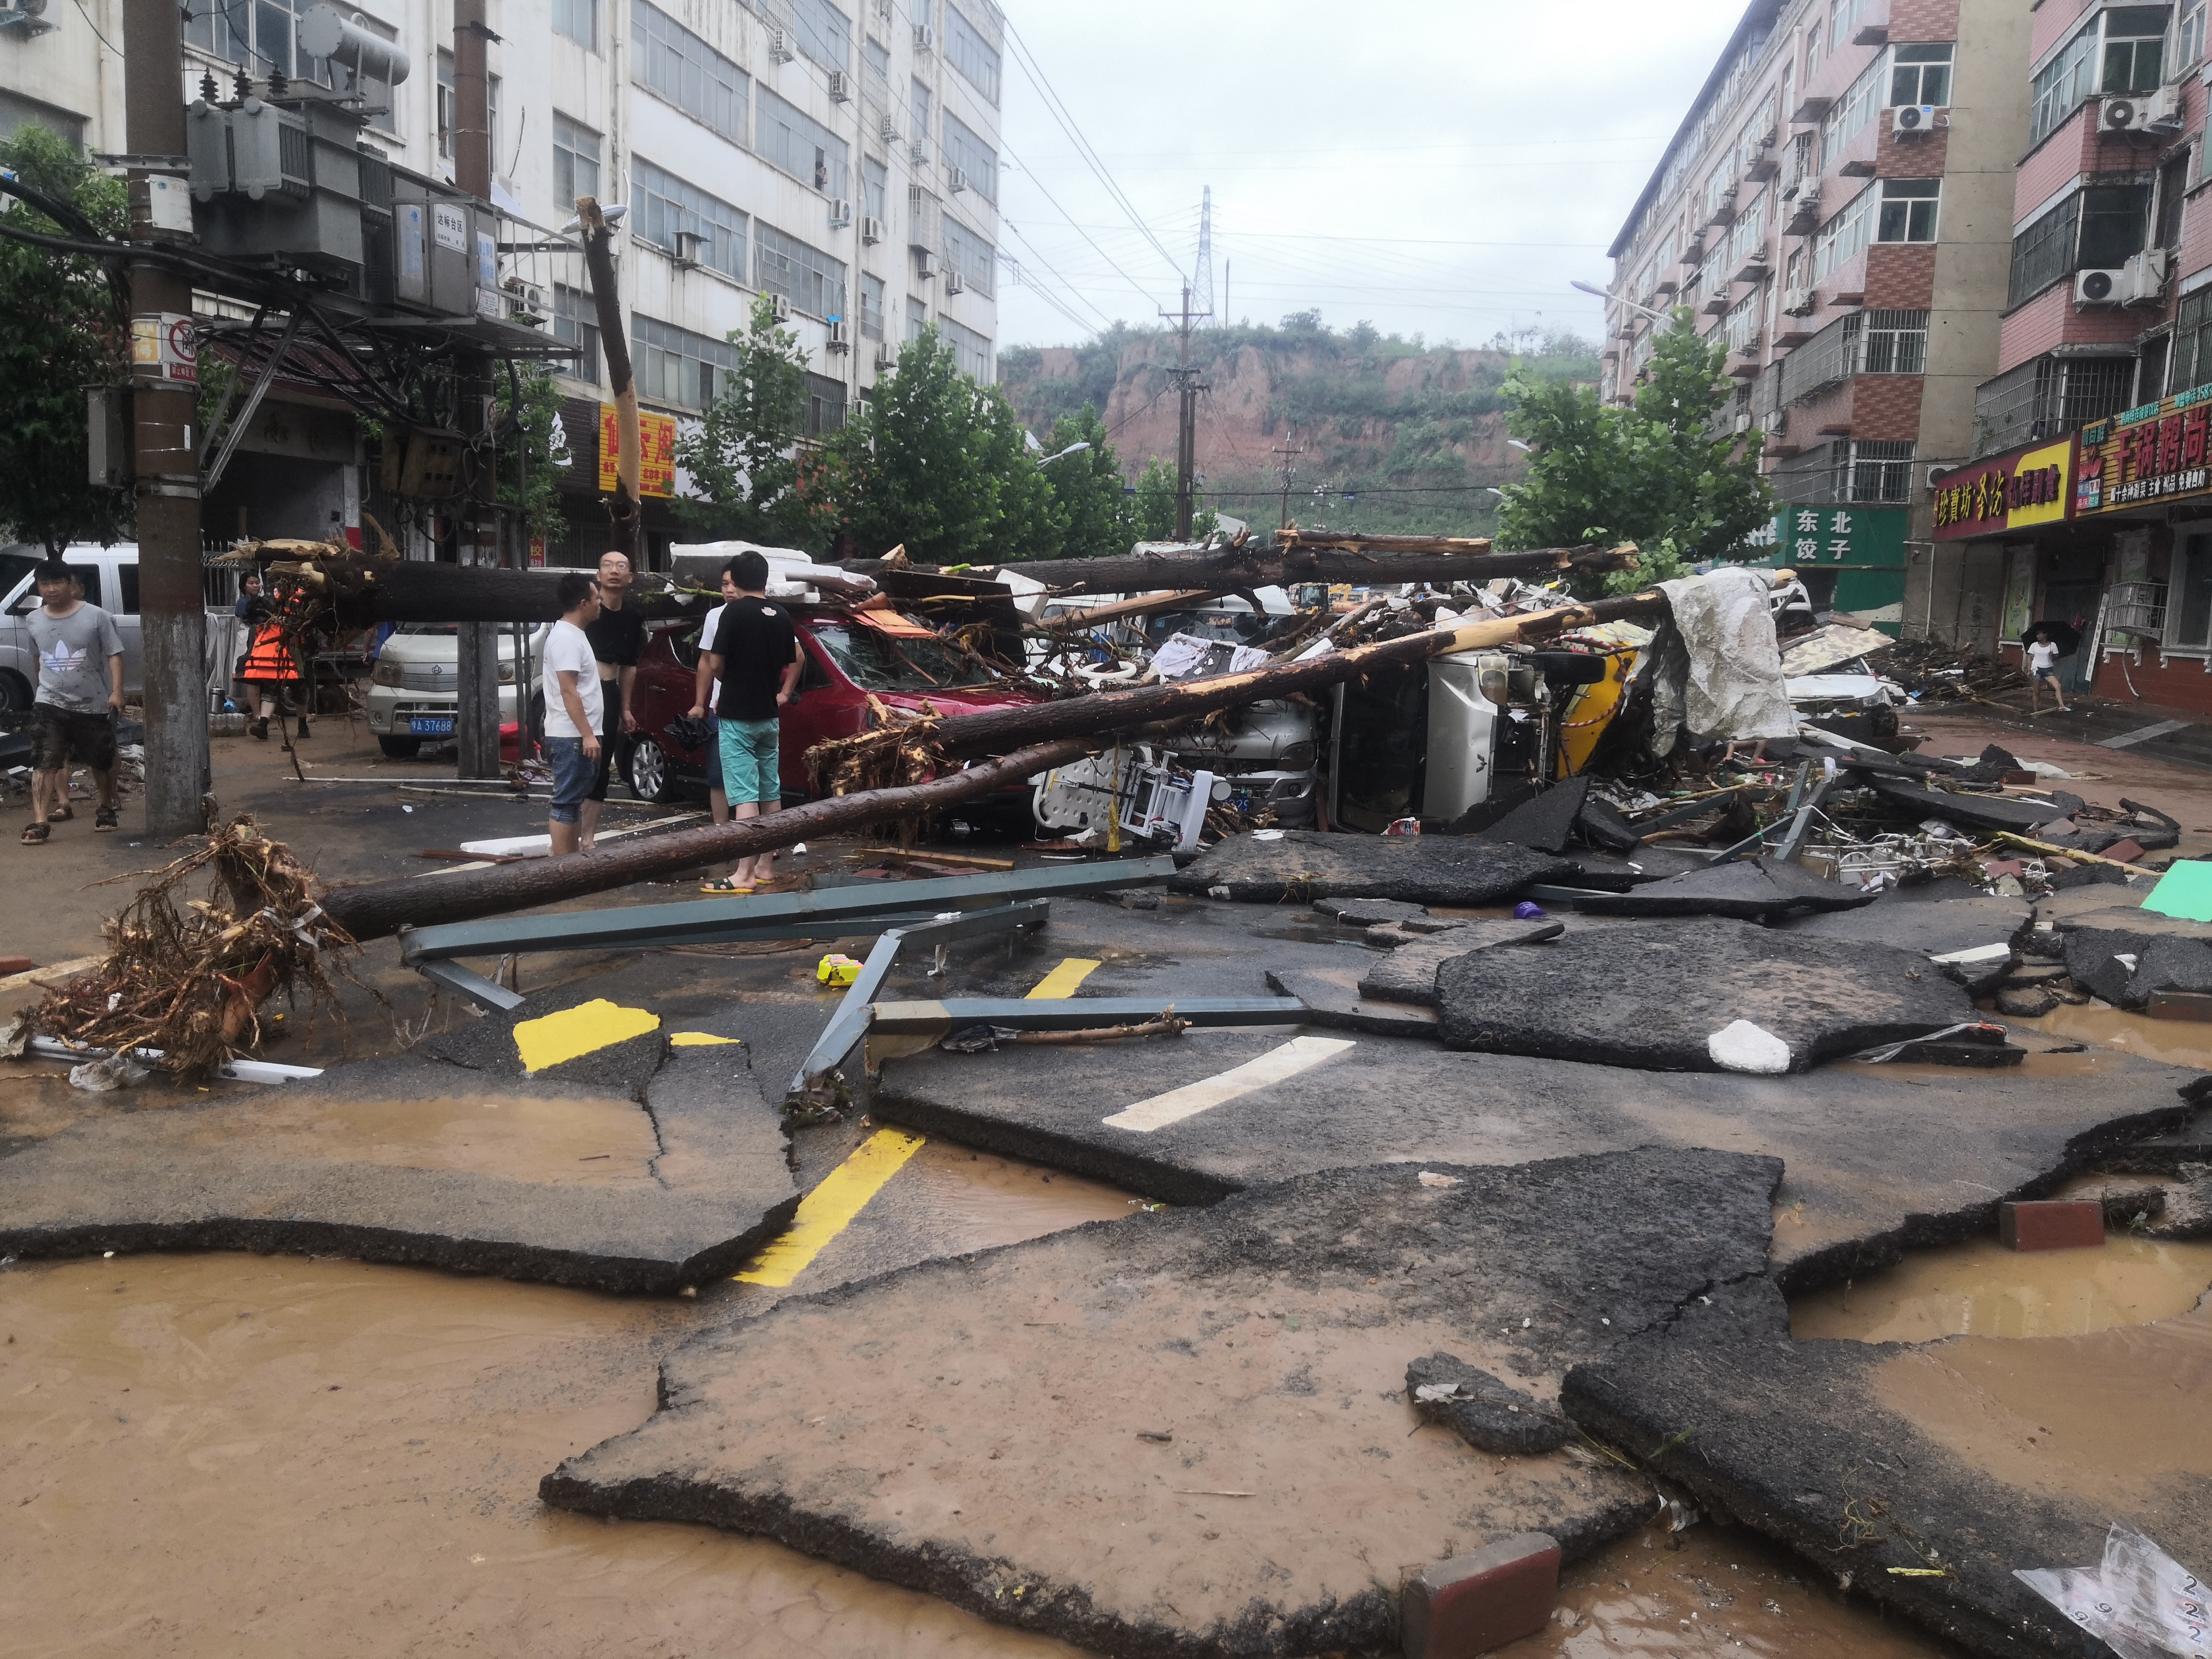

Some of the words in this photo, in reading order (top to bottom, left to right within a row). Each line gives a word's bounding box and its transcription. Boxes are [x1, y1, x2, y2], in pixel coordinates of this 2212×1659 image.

[437, 212, 463, 233] 达标台区
[1796, 510, 1852, 534] 东北
[530, 544, 542, 556] 校
[1795, 538, 1851, 560] 饺子
